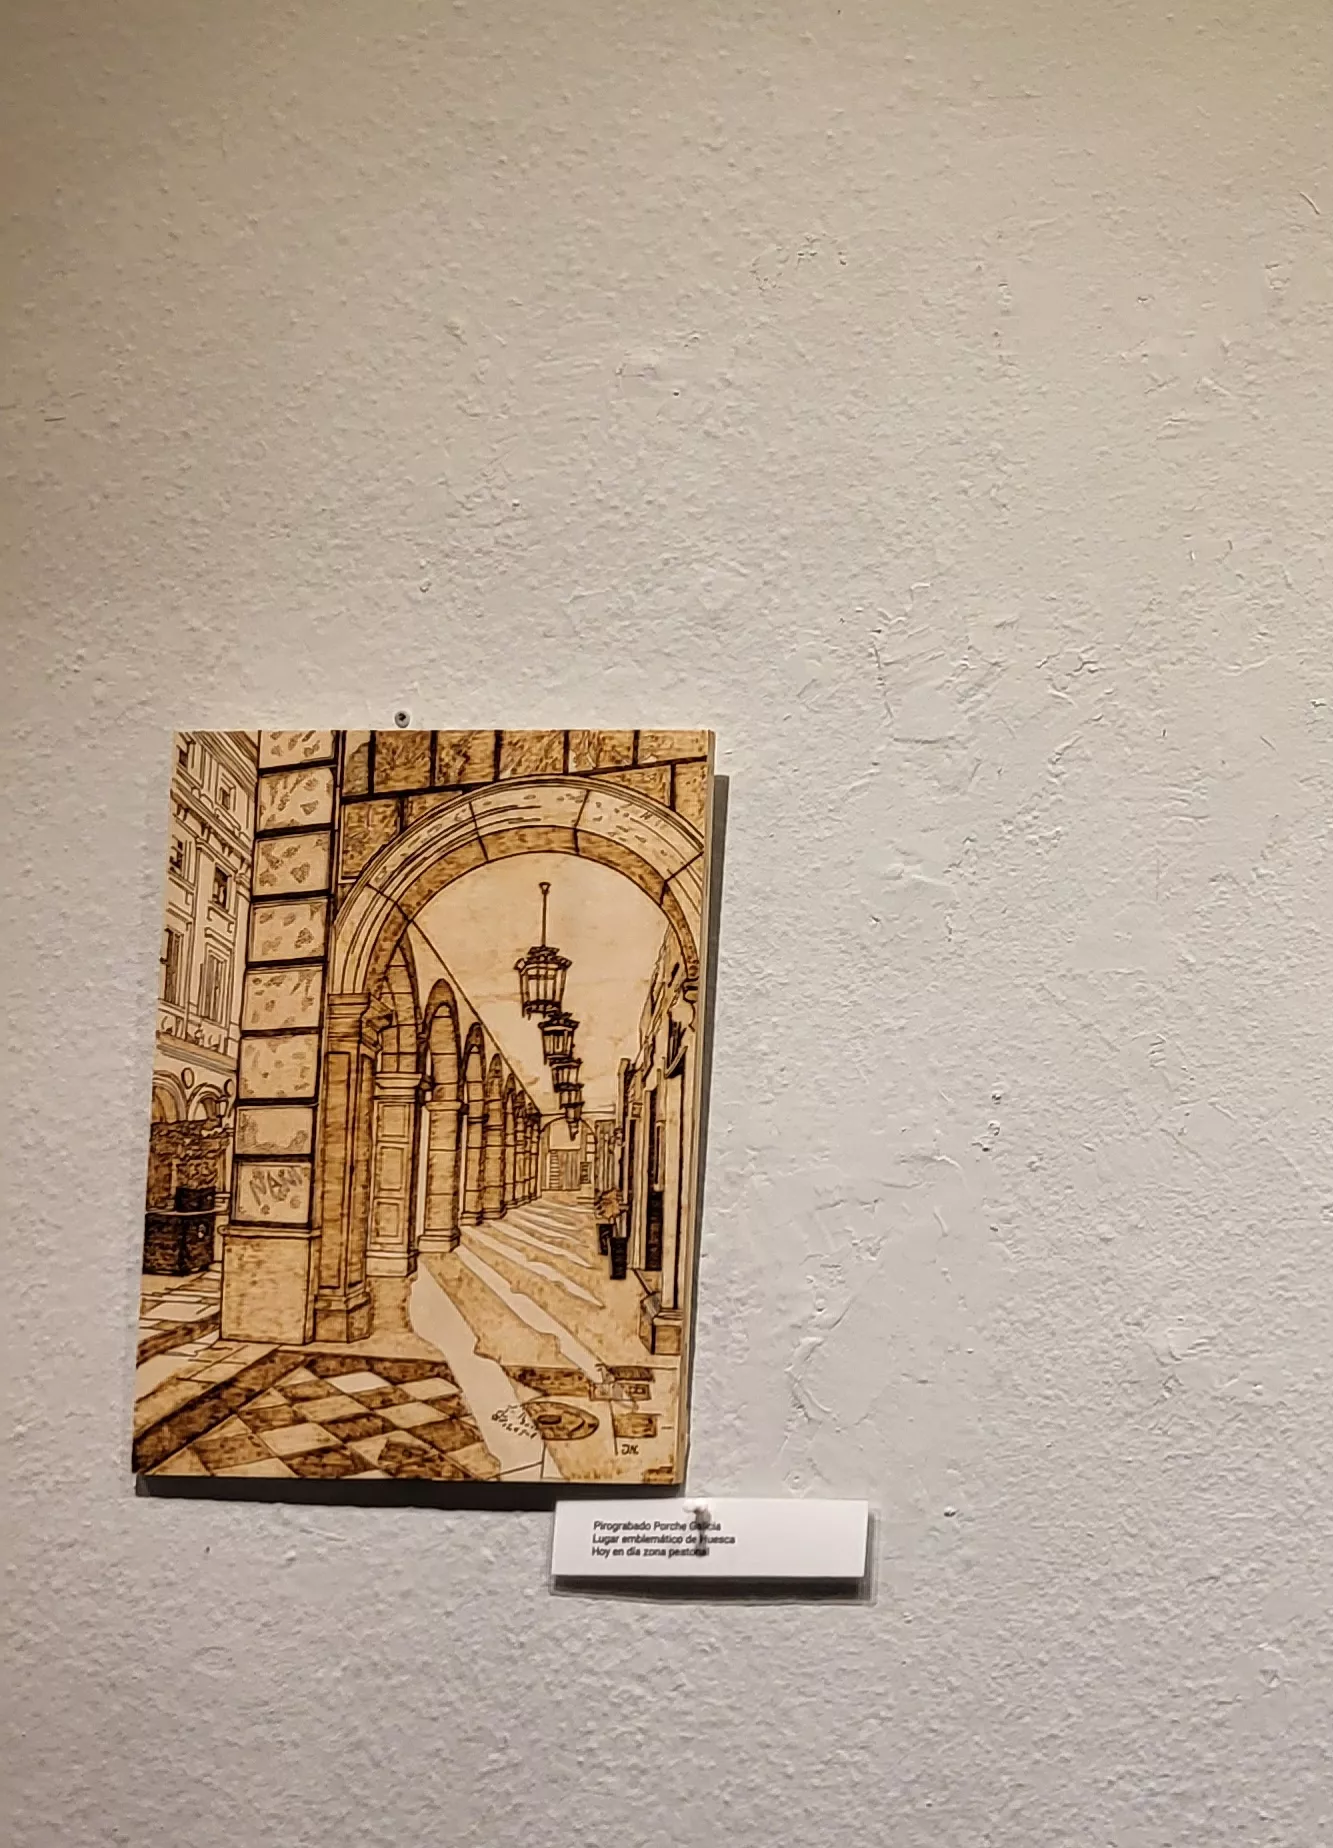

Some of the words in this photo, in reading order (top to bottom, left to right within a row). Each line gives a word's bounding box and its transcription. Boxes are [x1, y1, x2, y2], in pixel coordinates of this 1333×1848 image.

[593, 1520, 652, 1533] Pirograbado
[653, 1521, 687, 1531] Porche
[592, 1534, 620, 1545] Lugar
[621, 1533, 684, 1544] emblemático
[685, 1533, 698, 1543] de
[591, 1547, 611, 1559] Hoy
[612, 1549, 625, 1557] en
[626, 1546, 642, 1557] día
[643, 1549, 667, 1557] zona
